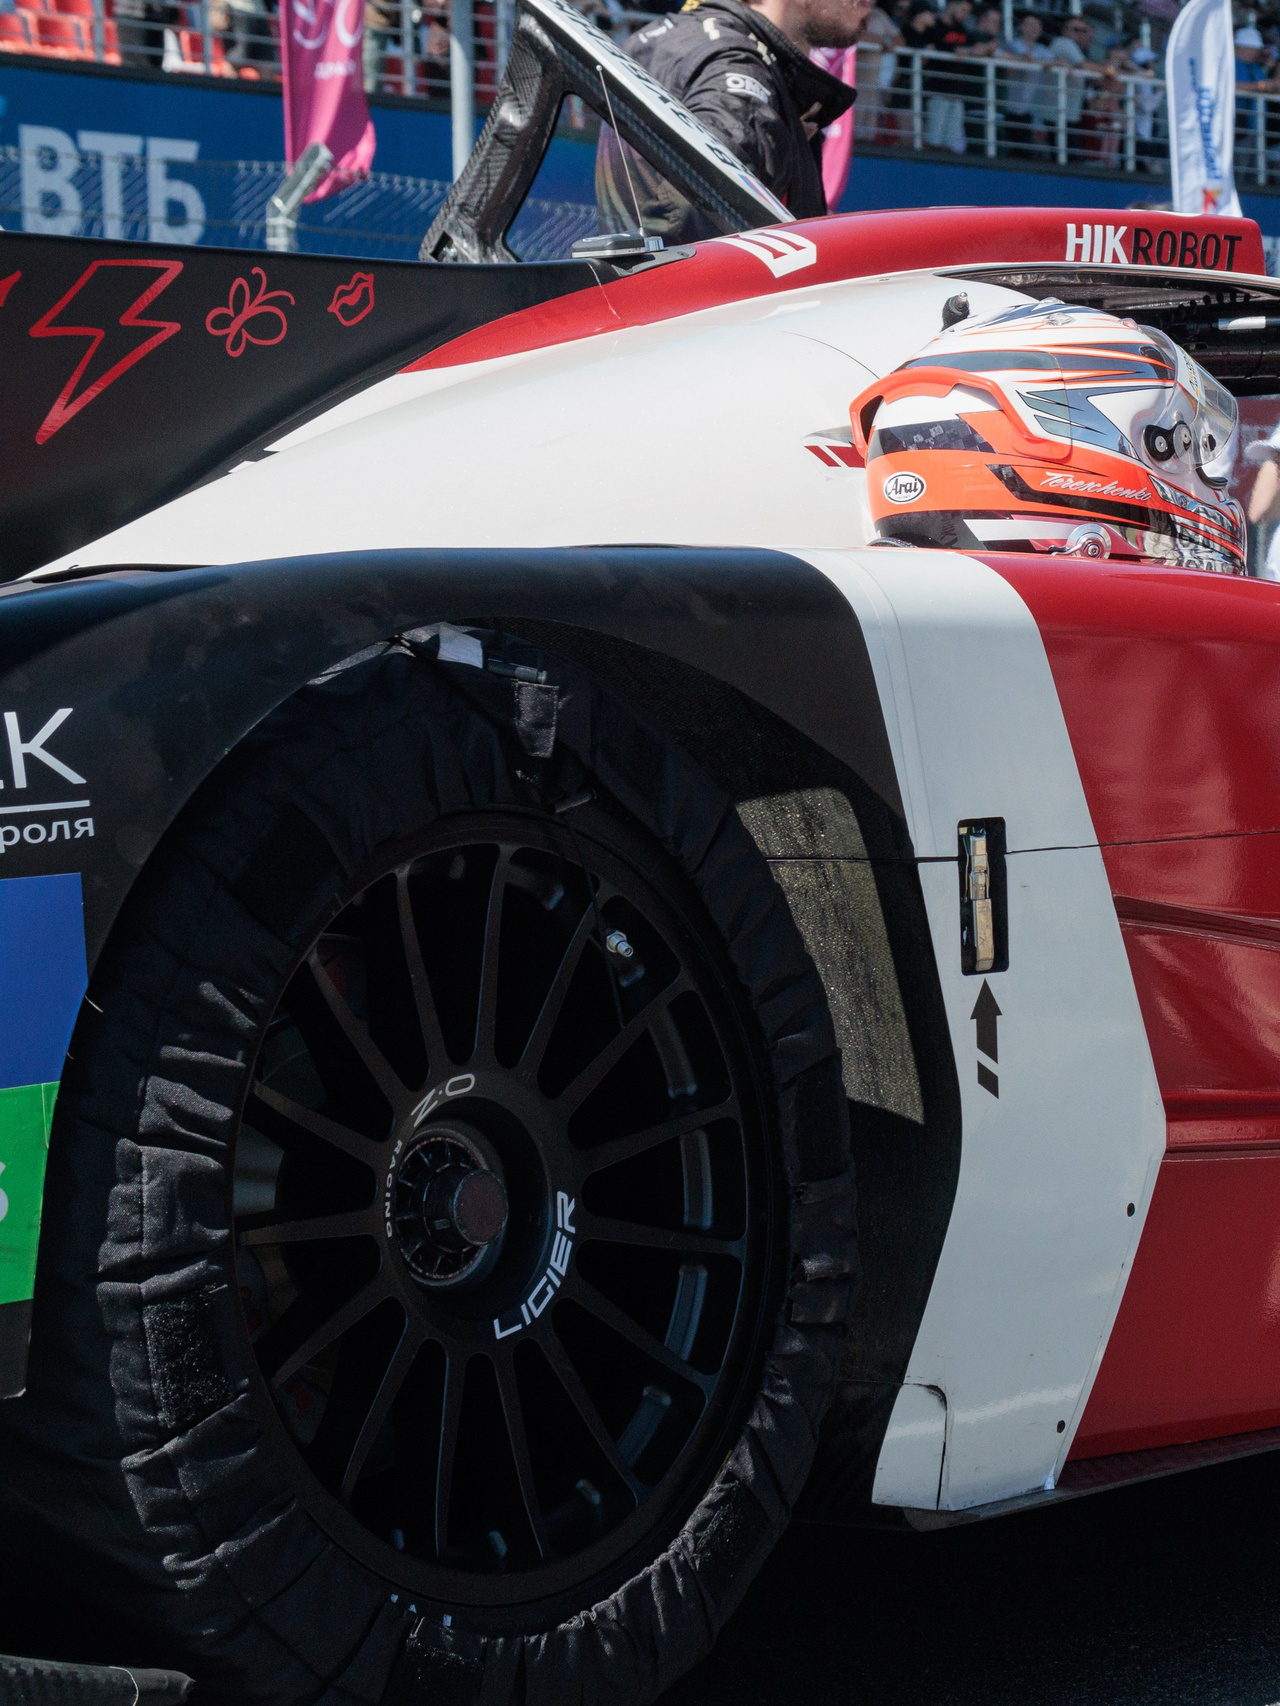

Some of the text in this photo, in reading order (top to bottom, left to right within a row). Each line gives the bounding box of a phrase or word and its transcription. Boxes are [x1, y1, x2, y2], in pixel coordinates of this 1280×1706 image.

[18, 123, 207, 246] ВТБ
[1065, 223, 1242, 272] HIKROBOT
[887, 477, 919, 495] Arai
[0, 817, 95, 854] роля
[384, 1139, 403, 1238] RACING
[493, 1190, 577, 1340] LIGIER
